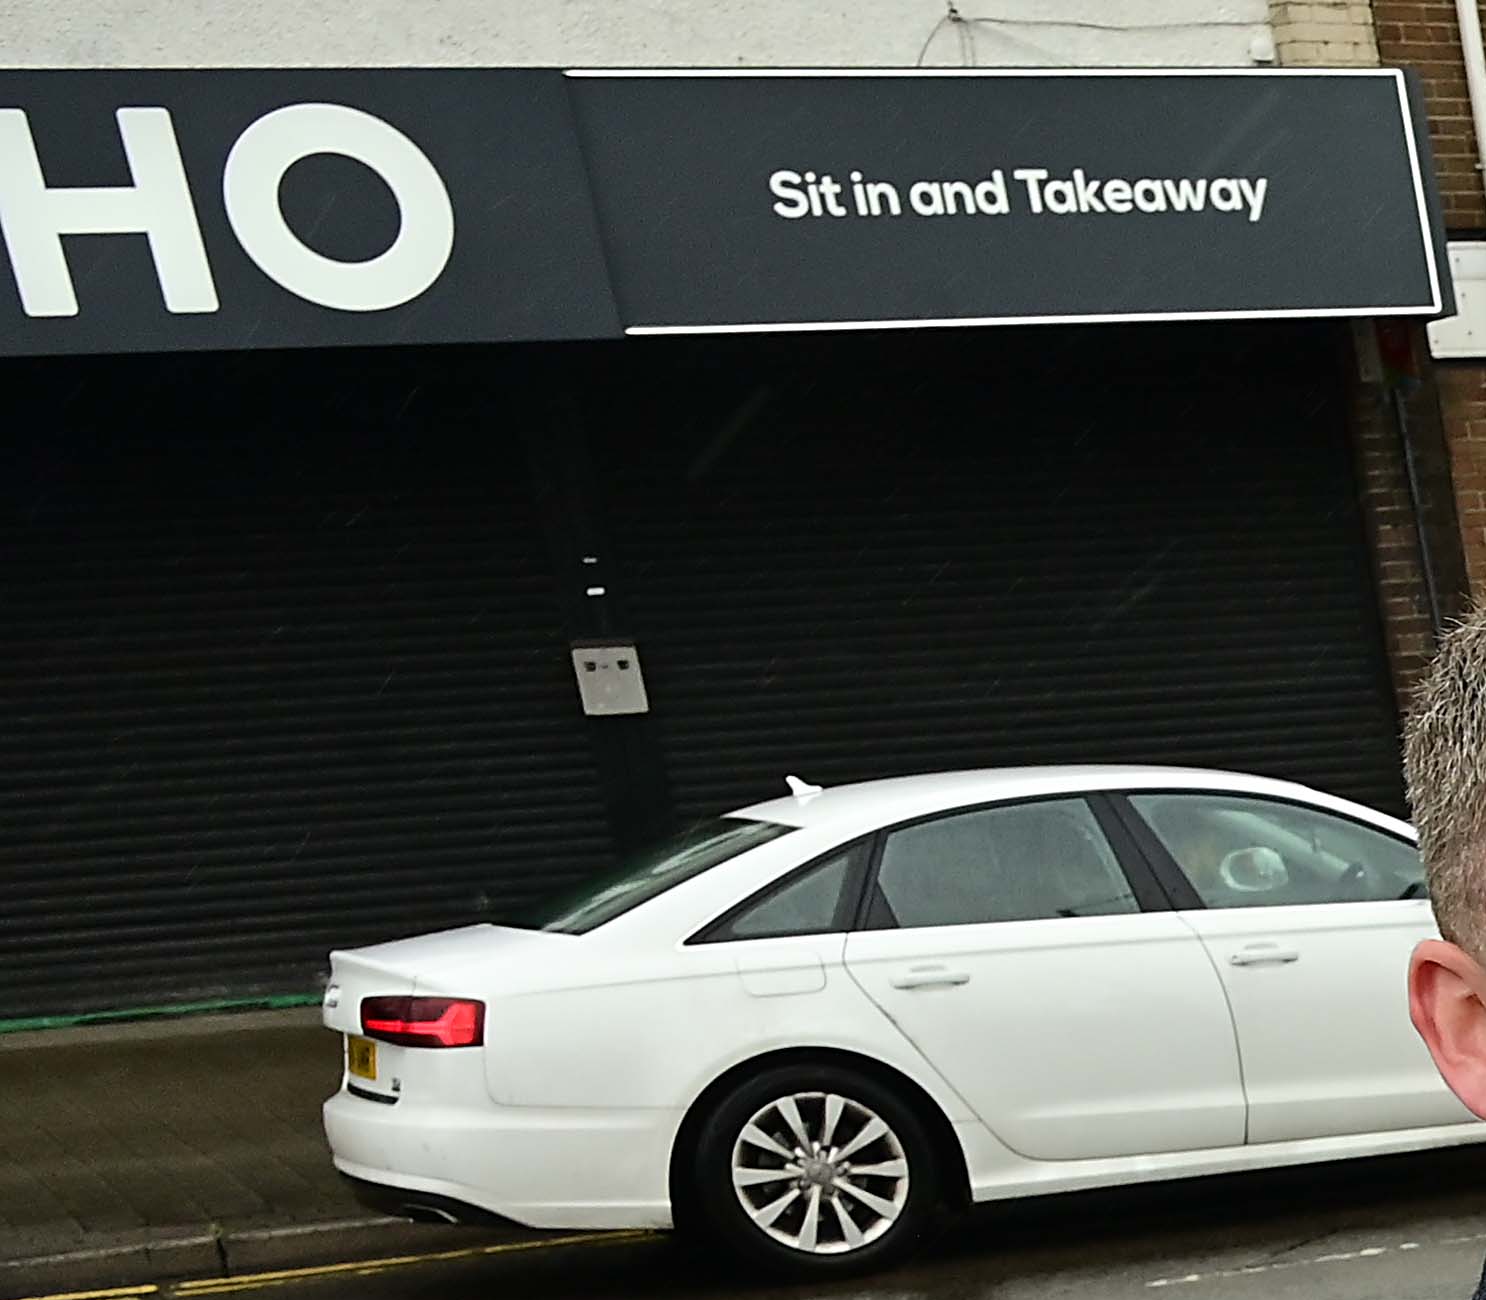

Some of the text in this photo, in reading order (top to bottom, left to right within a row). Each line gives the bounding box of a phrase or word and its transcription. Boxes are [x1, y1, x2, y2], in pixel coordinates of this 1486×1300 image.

[769, 168, 1267, 222] Sit in and Takeaway
